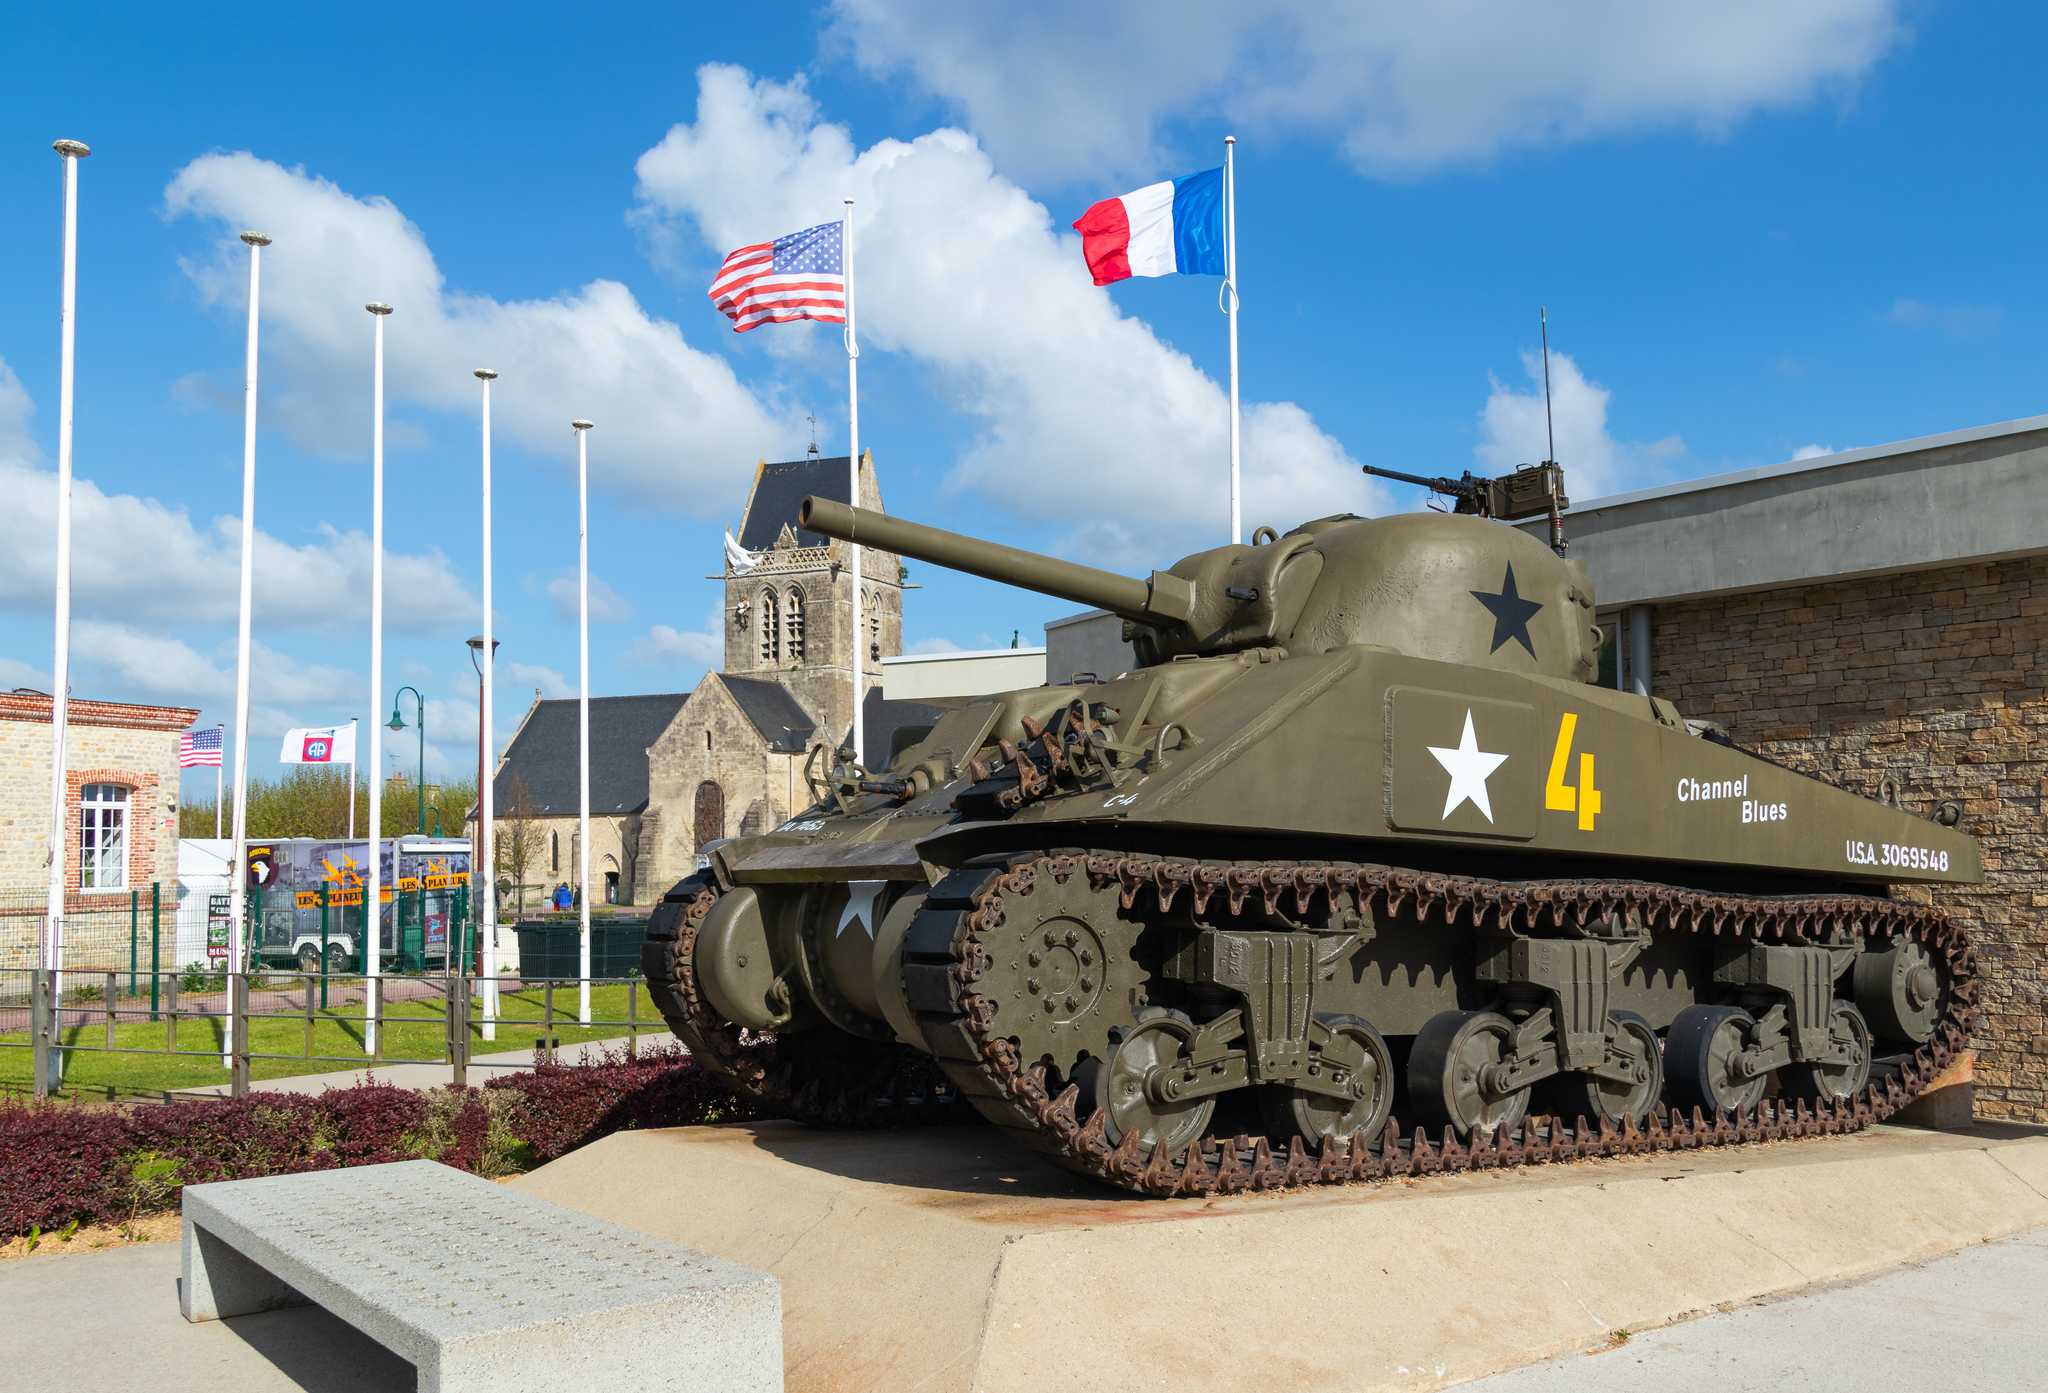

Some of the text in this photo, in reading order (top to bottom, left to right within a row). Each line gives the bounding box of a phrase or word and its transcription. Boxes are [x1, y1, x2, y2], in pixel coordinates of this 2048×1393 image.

[1545, 712, 1601, 831] 4
[1677, 774, 1748, 802] Channel
[1742, 800, 1787, 824] Blues
[1881, 843, 1949, 872] 3069548
